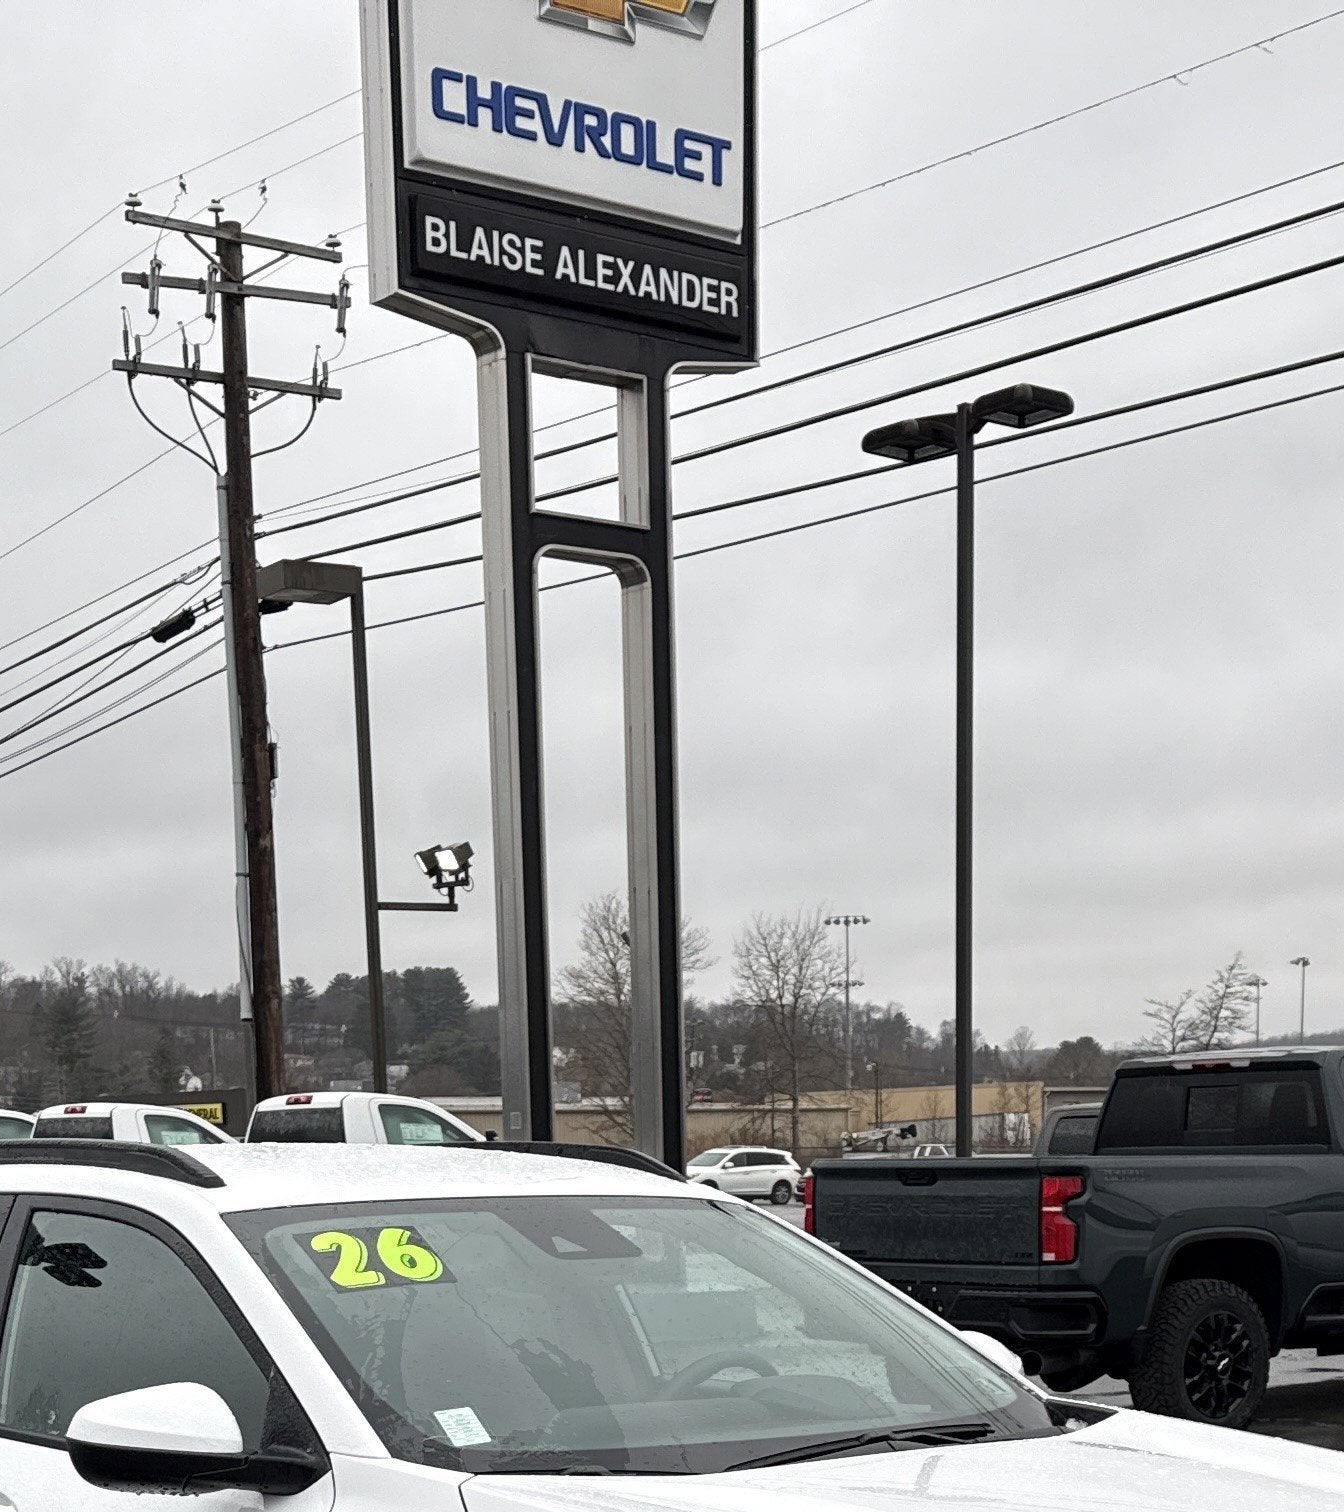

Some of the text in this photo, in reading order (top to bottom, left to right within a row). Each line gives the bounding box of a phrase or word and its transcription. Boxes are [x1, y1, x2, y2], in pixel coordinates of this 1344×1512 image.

[431, 66, 732, 187] CHEVROLET
[424, 214, 739, 318] BLAISE ALEXANDER
[311, 1228, 444, 1288] 26
